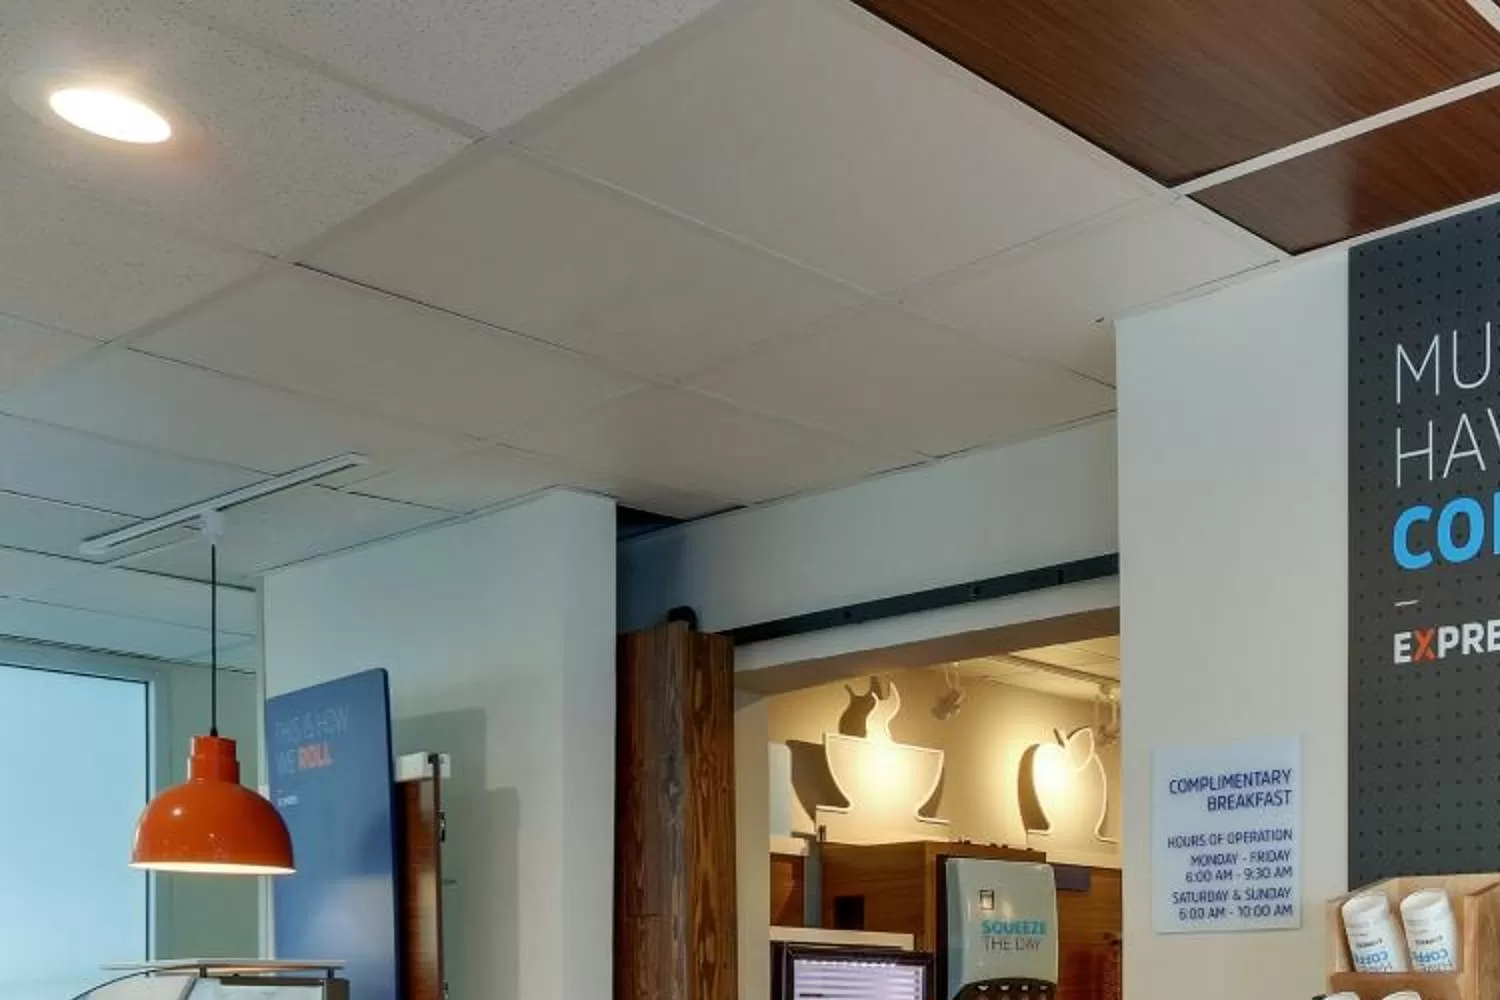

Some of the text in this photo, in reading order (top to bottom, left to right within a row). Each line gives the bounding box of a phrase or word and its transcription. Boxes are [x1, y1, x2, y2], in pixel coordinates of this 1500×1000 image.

[1168, 768, 1293, 795] COMPLIMENTARY
[1207, 788, 1293, 812] BREAKFAST
[1167, 827, 1293, 848] HOURS OF OPERATION
[1190, 852, 1239, 867] MONDAY
[1250, 849, 1292, 863] FRIDAY
[1185, 870, 1213, 883] 6:00
[1215, 869, 1233, 881] AM
[1243, 867, 1270, 881] 9:30
[1273, 865, 1294, 878] AM
[1172, 889, 1229, 905] SATURDAY
[1244, 887, 1292, 901] SUNDAY
[1179, 908, 1204, 921] 6:00
[1207, 907, 1226, 919] AM
[1238, 904, 1271, 918] 10:00
[1273, 903, 1294, 917] AM
[981, 919, 1047, 936] SQUEEZE
[983, 935, 1013, 952] THE
